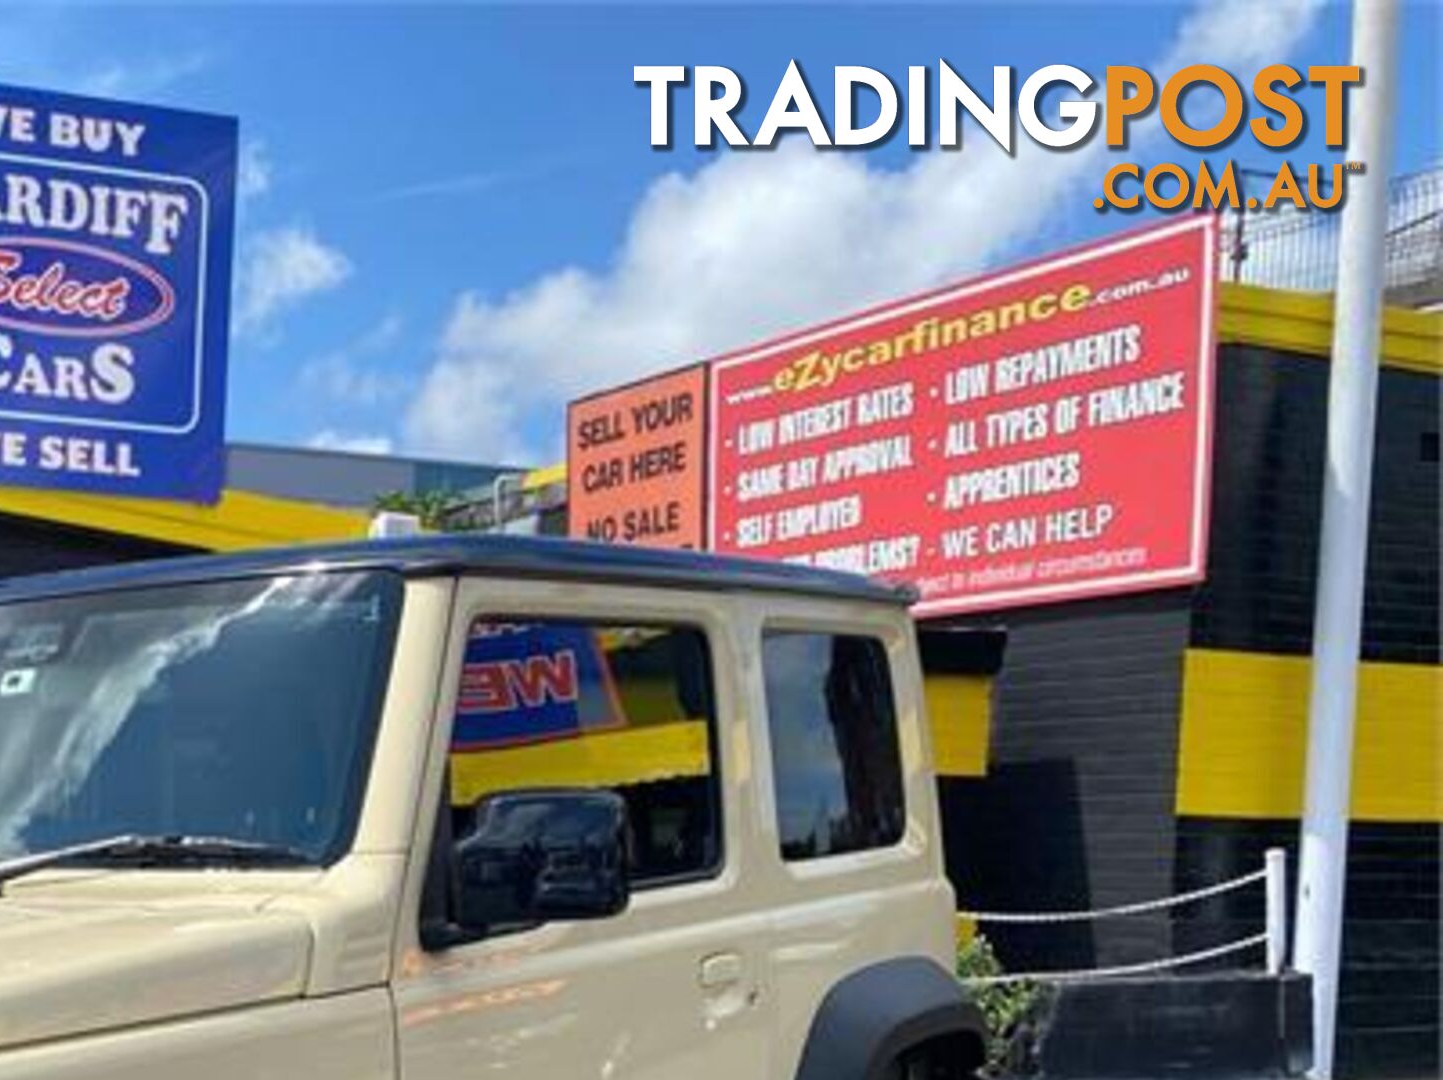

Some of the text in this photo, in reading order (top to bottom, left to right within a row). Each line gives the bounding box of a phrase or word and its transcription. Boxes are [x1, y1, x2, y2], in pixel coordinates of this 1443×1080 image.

[50, 113, 146, 157] BUY
[945, 323, 1141, 405] LOW REPAYMENTS
[577, 392, 694, 451] SELL YOUR
[738, 381, 914, 455] LOW INTEREST RATES
[944, 371, 1185, 458] ALL TYPES OF FINANCE
[39, 435, 141, 477] SELL
[581, 440, 686, 493] CAR HERE
[823, 435, 914, 484] APPROVAL
[943, 452, 1080, 510] APPRENTICES
[623, 501, 681, 541] SALE
[736, 512, 773, 549] SELF
[940, 504, 1114, 559] WE CAN HELP
